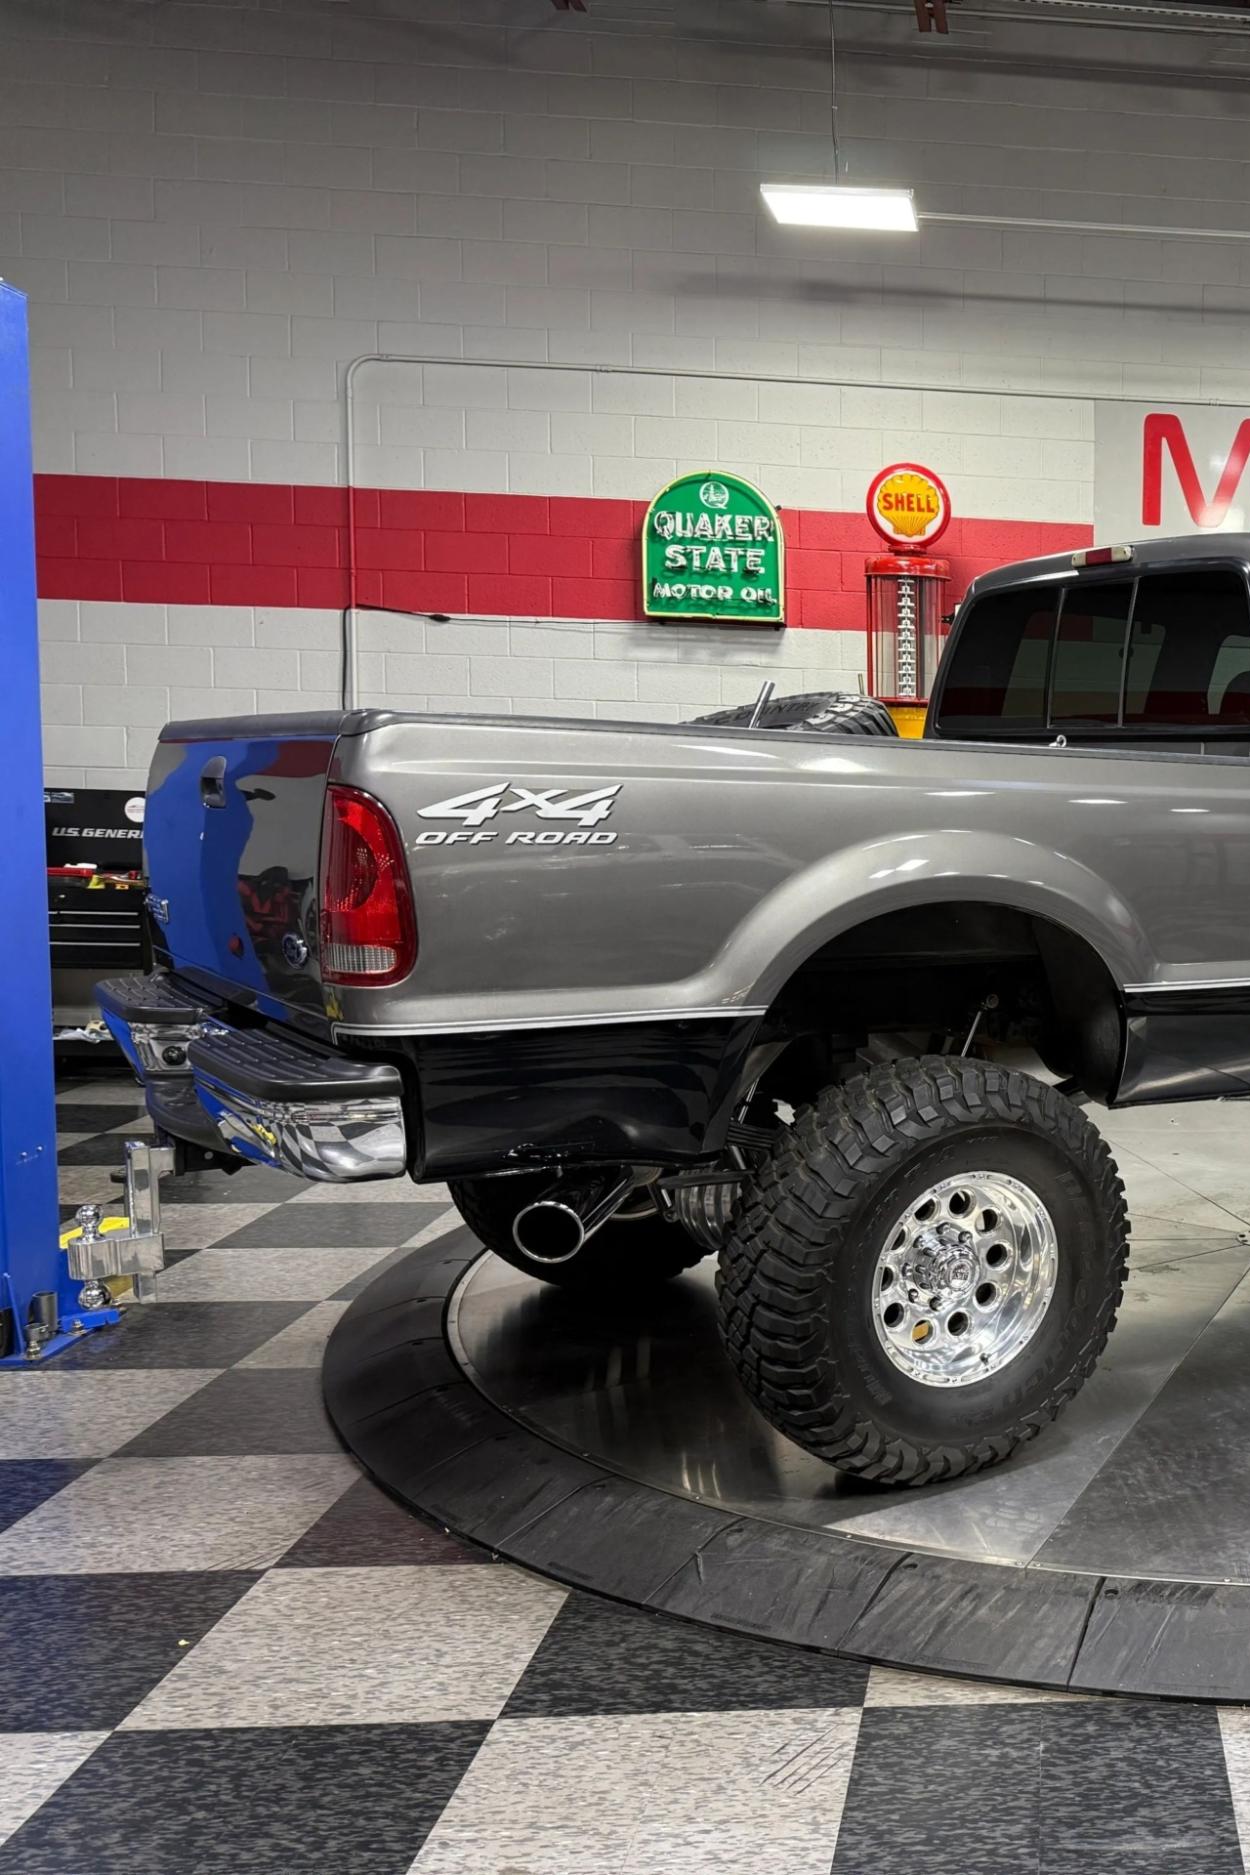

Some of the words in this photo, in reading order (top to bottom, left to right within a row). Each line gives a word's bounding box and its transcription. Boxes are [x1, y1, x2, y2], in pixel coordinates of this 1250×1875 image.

[882, 492, 935, 514] SHELL
[654, 510, 775, 542] QUAKER
[665, 544, 766, 574] STATE
[653, 582, 734, 601] MOTOR
[740, 586, 777, 604] OIL
[415, 831, 498, 845] OFF
[505, 831, 618, 846] ROAD
